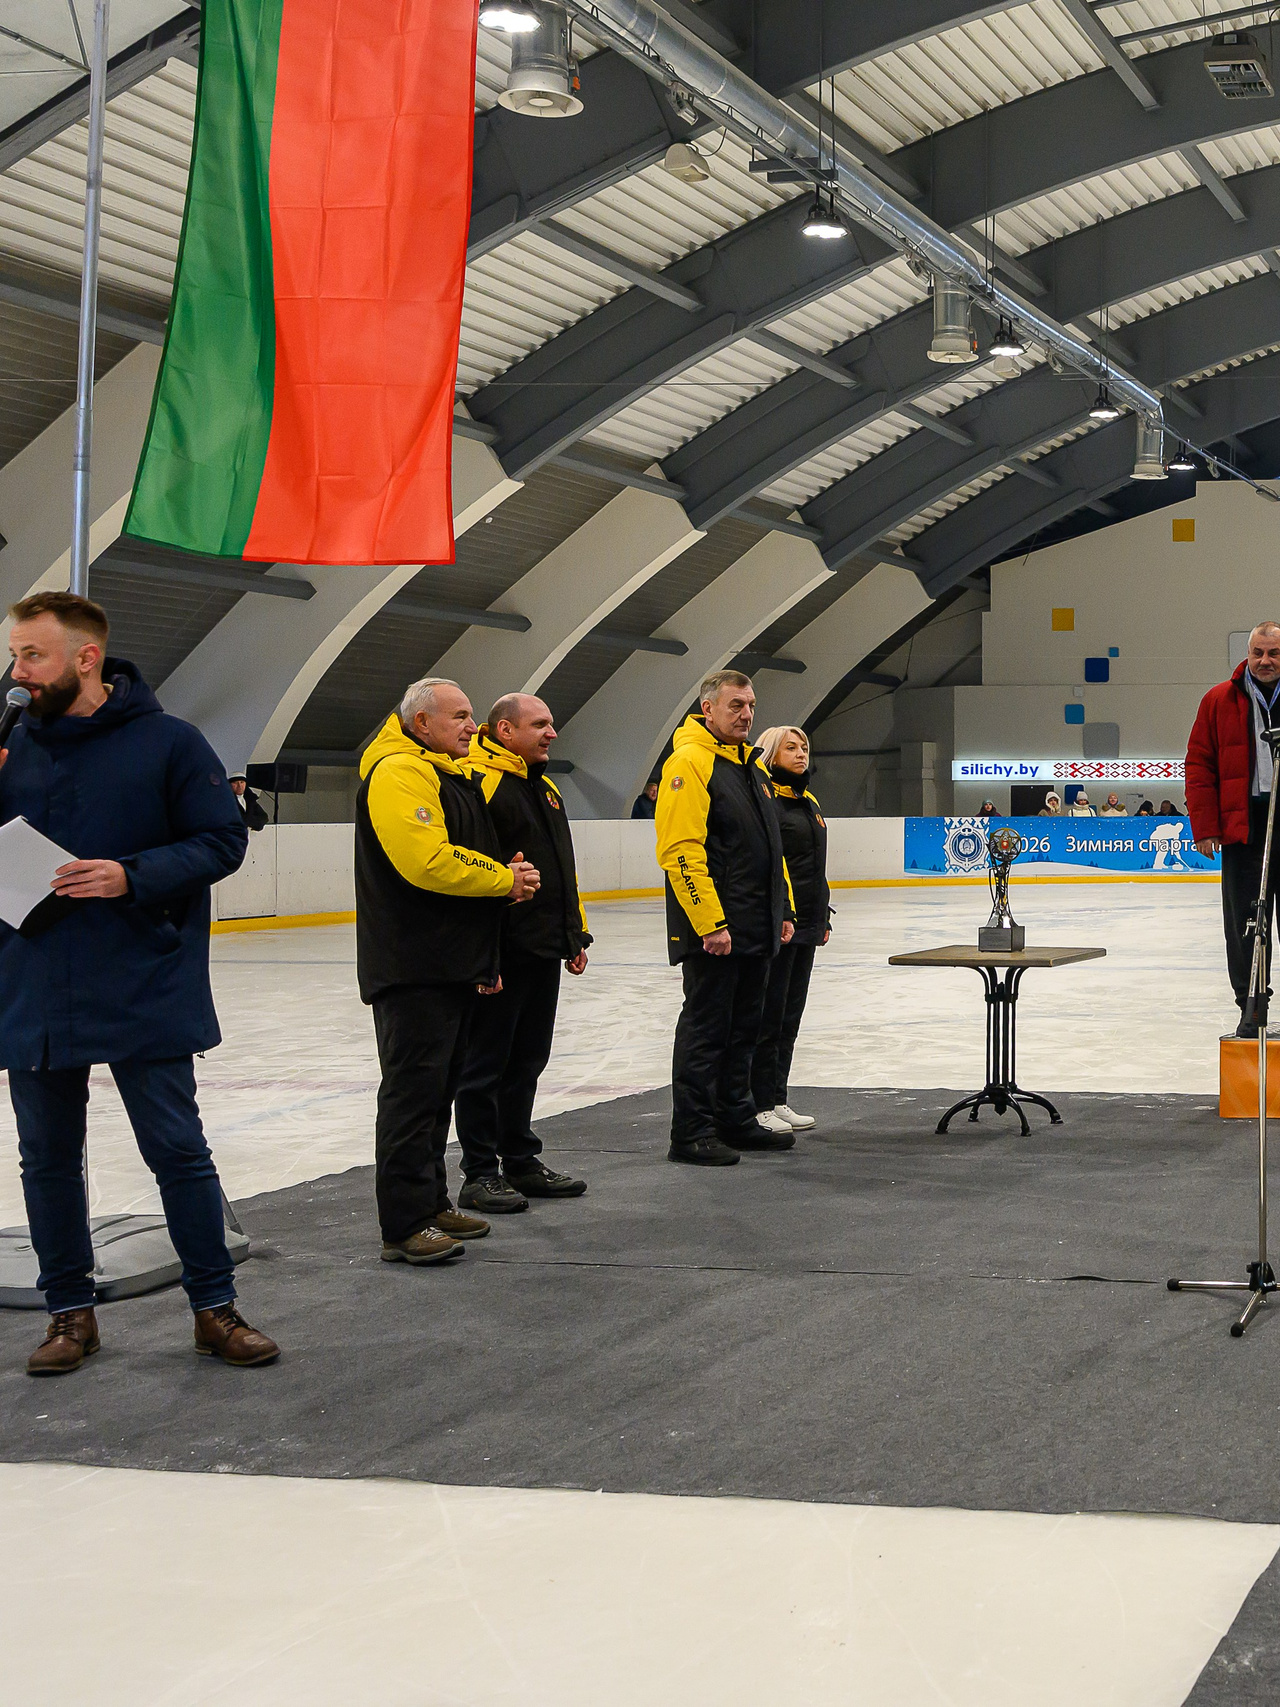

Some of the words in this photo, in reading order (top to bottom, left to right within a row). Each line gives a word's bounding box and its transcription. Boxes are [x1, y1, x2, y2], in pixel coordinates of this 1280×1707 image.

[961, 763, 1040, 778] silichy.by
[1018, 836, 1051, 853] 026
[1066, 836, 1134, 853] Зимняя
[677, 855, 702, 906] BELARUS
